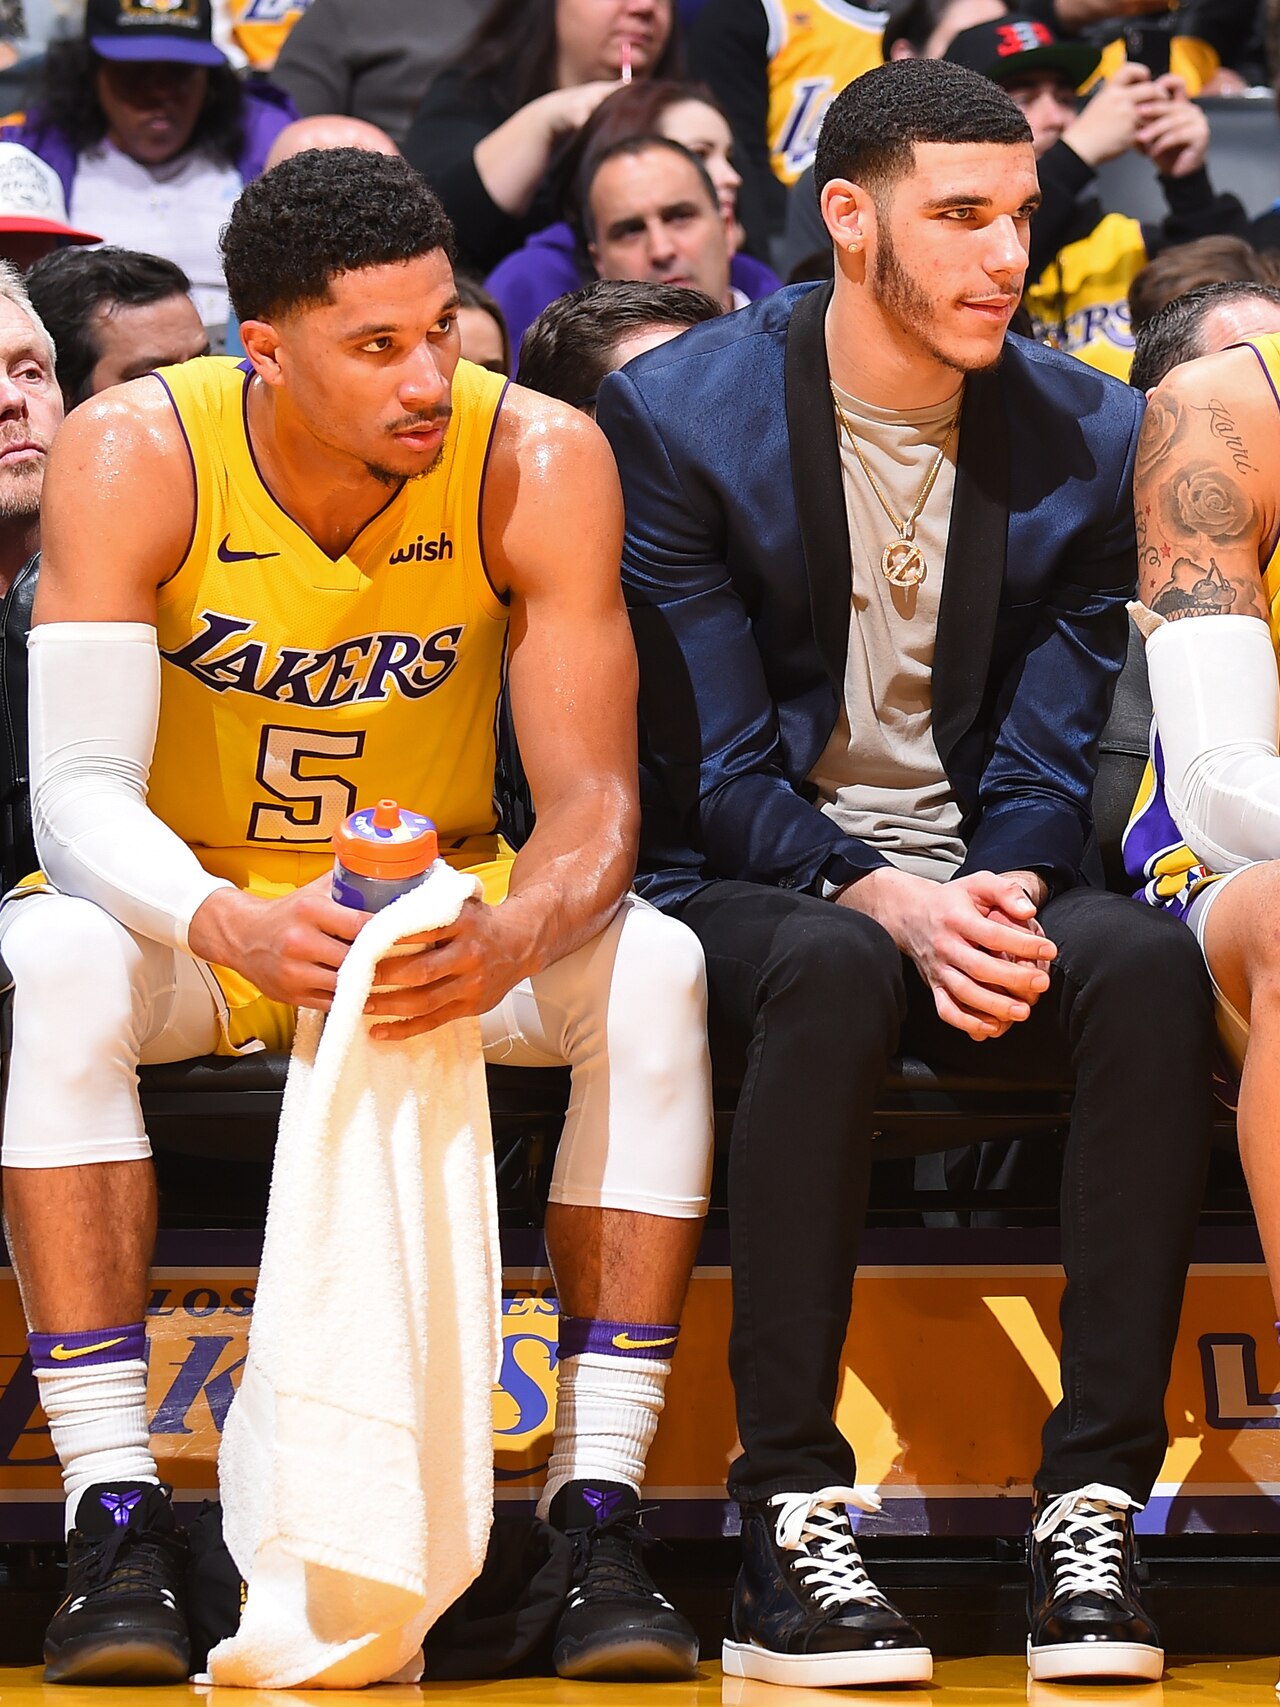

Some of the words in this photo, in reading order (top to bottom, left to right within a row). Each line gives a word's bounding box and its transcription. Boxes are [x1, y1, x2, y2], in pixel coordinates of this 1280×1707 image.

[389, 532, 454, 565] wish
[159, 609, 467, 710] LAKERS
[246, 724, 367, 844] 5
[146, 1287, 257, 1318] LOS
